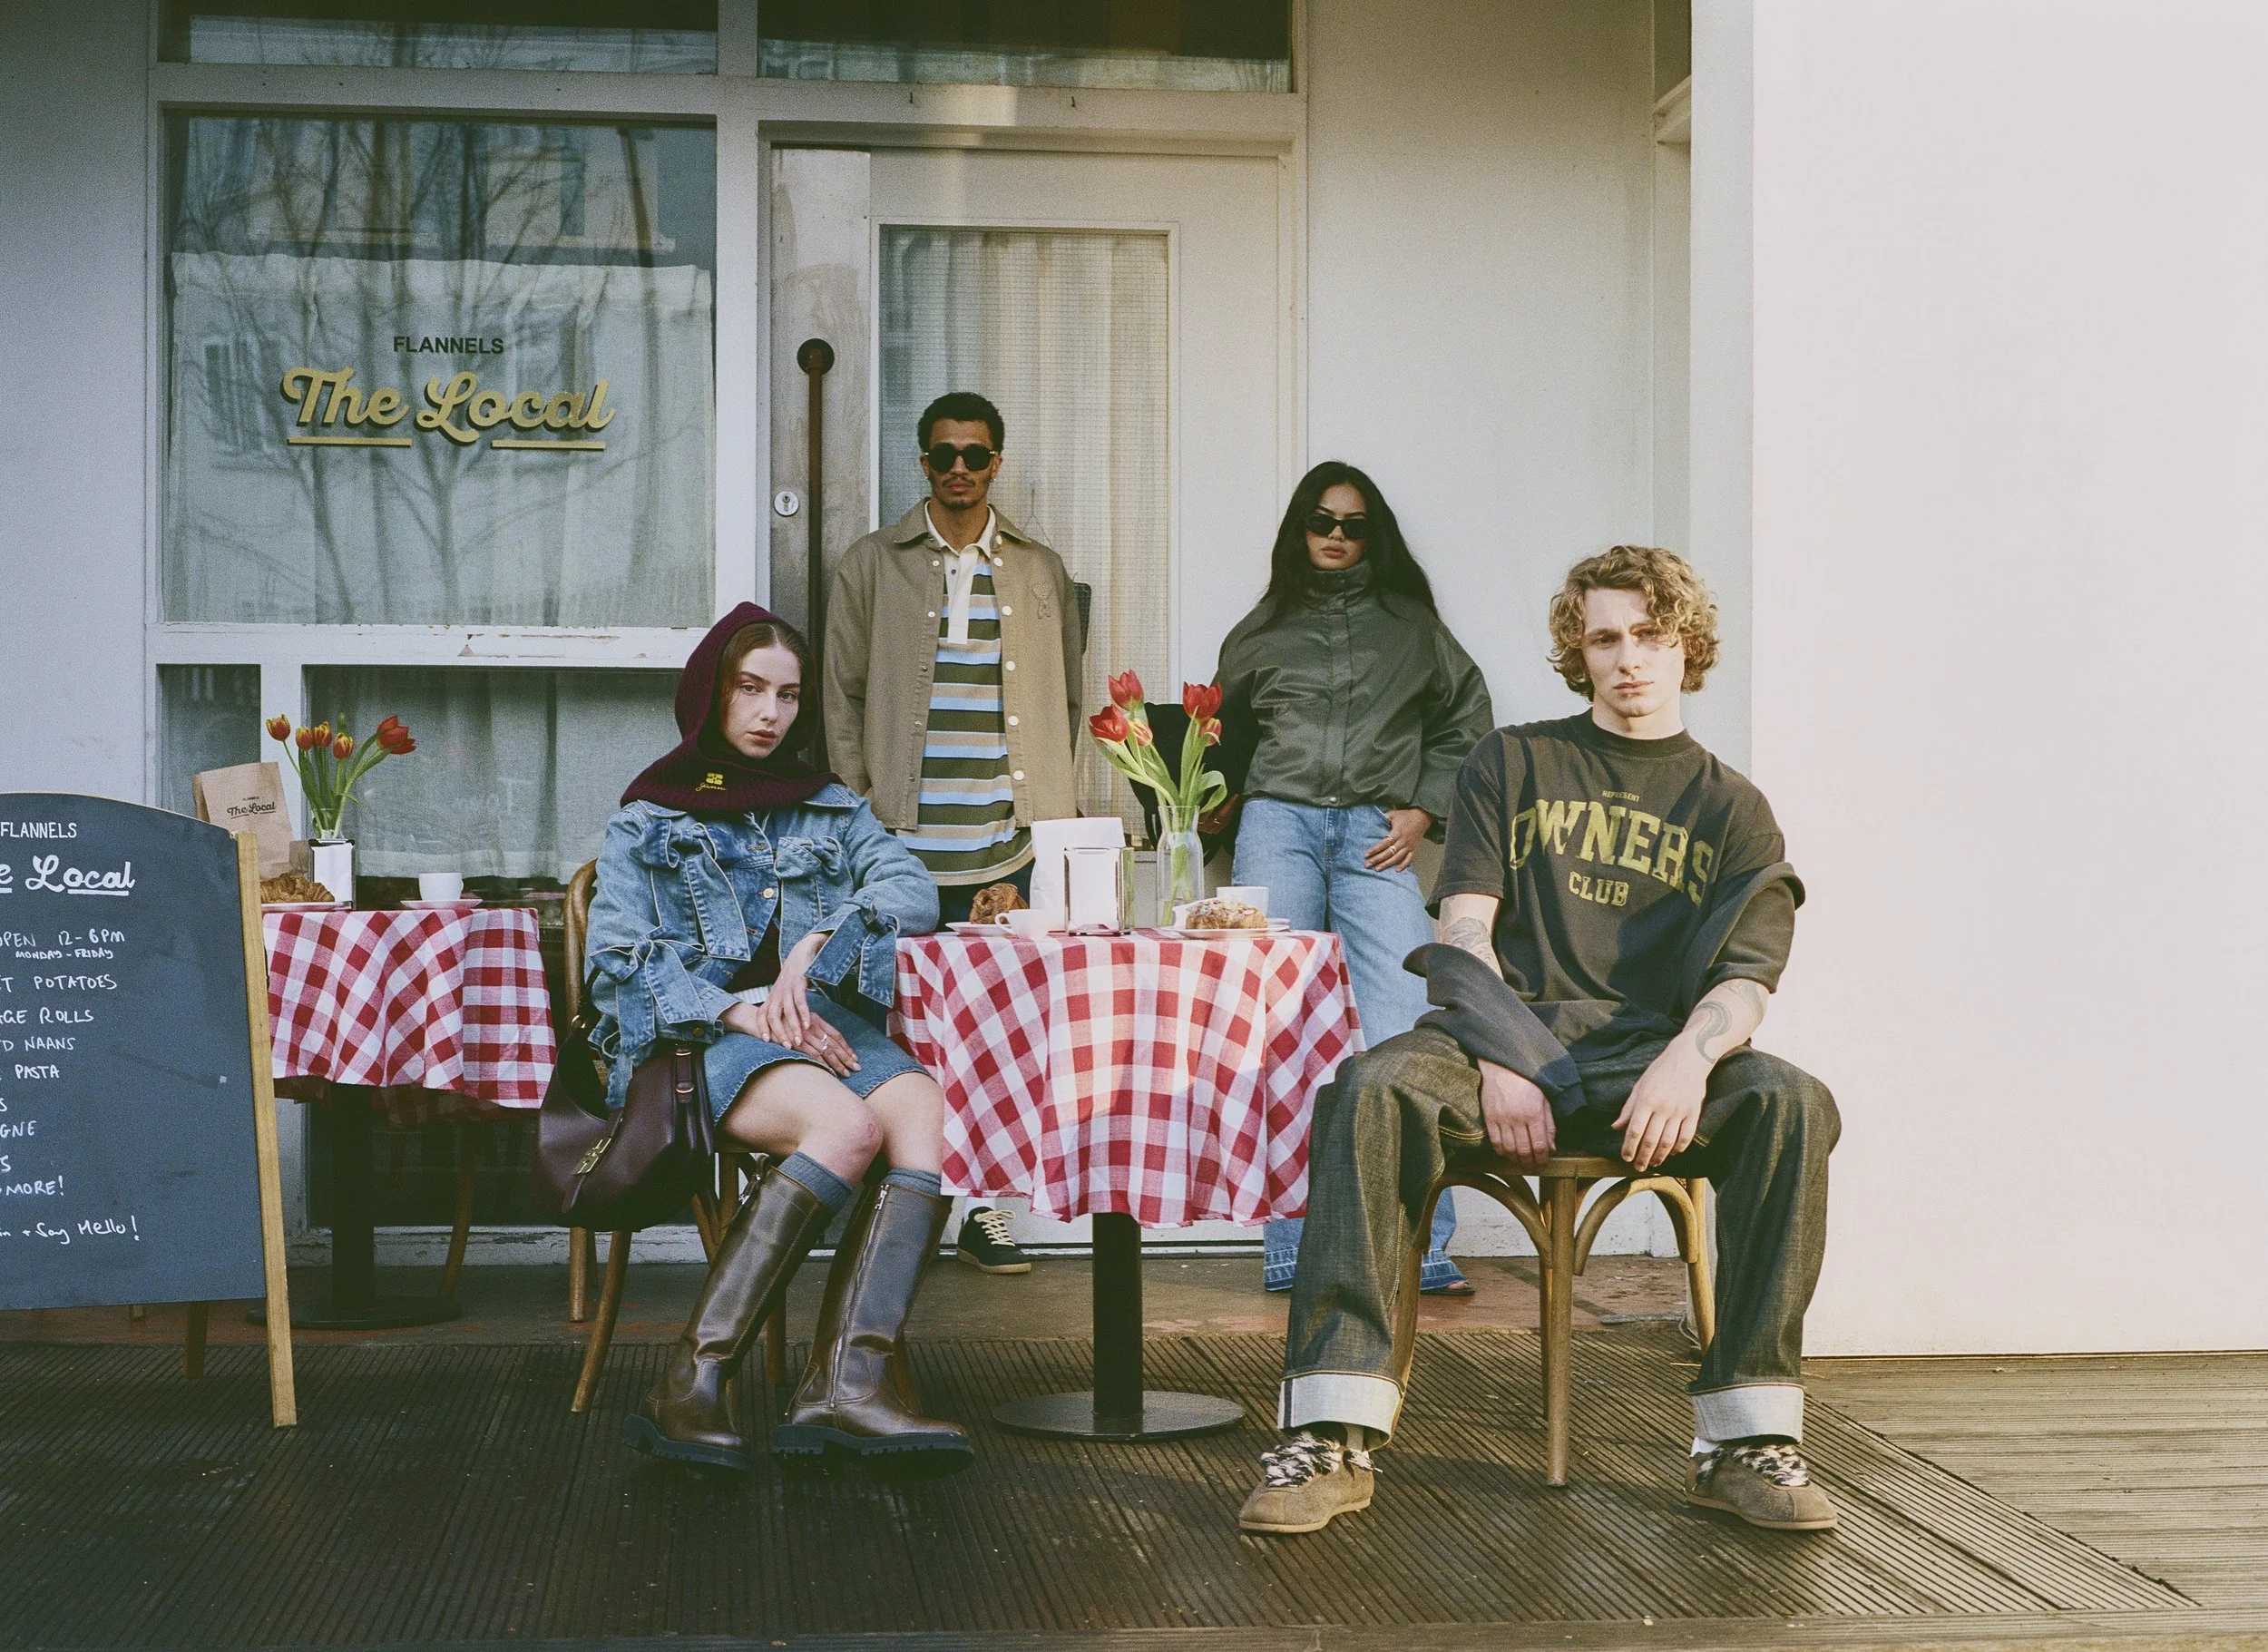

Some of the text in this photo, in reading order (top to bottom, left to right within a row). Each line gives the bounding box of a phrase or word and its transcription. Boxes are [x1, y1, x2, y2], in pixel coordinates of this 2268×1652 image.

[393, 336, 505, 355] FLANNELS
[279, 367, 617, 444] The Local
[227, 801, 277, 816] The Local
[0, 821, 78, 839] FLANNELS
[1510, 798, 1714, 906] OWNERS
[24, 854, 136, 893] Local
[1569, 871, 1630, 906] CLUB
[34, 973, 118, 991] POTATOES
[39, 1006, 94, 1024] ROLLS
[24, 1035, 76, 1051] NAANS
[15, 1063, 60, 1080] PASTA
[5, 1175, 64, 1197] MORE!
[34, 1222, 71, 1245] Say
